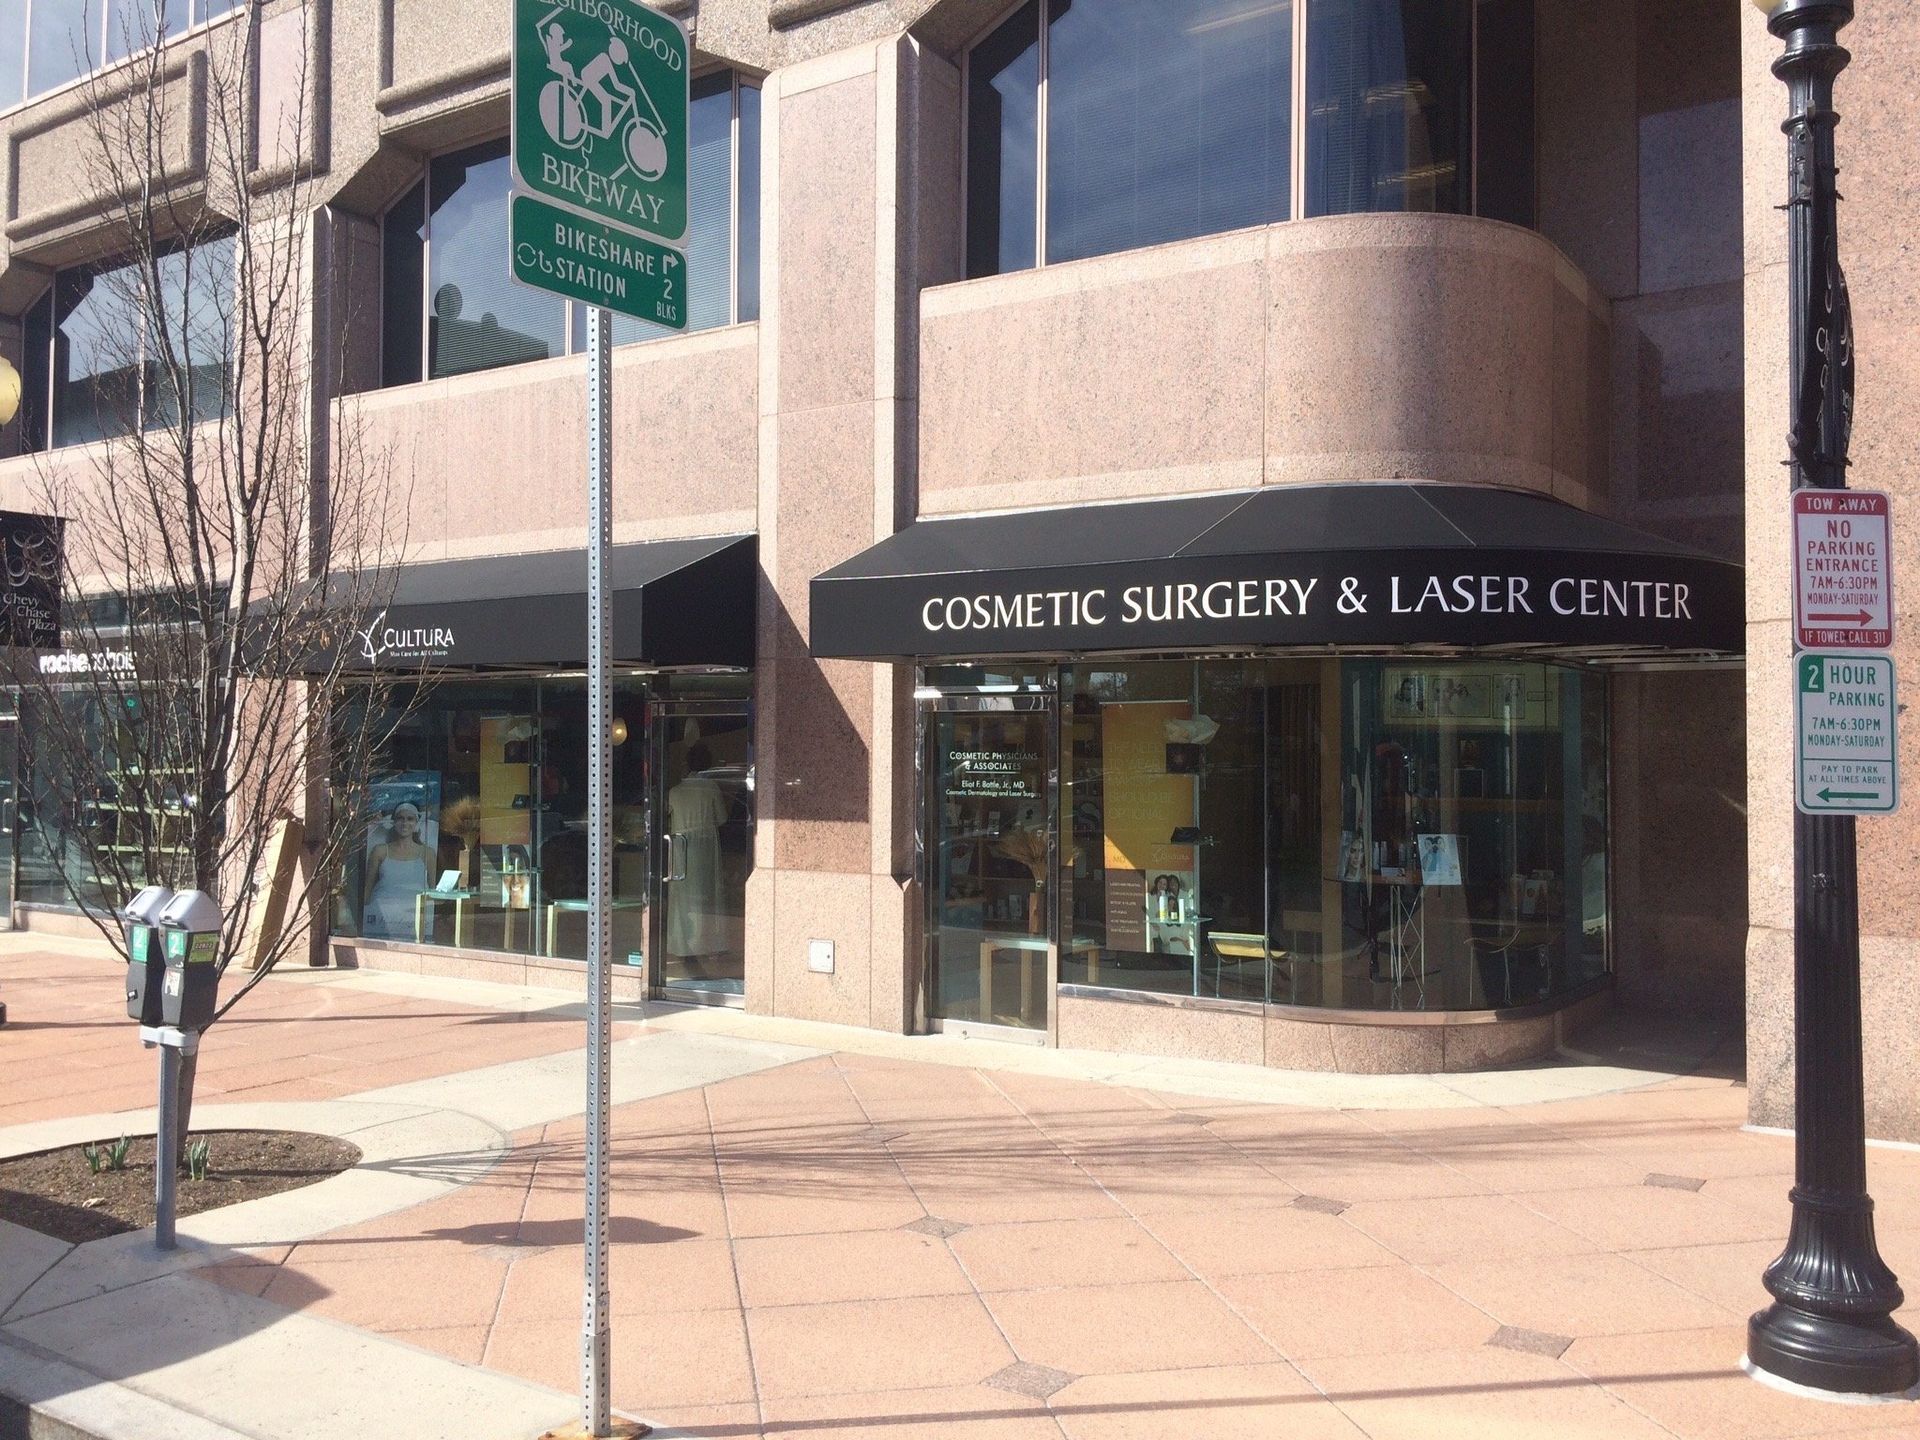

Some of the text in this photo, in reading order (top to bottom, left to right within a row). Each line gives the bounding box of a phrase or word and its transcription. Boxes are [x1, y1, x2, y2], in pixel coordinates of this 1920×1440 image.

[537, 0, 681, 71] BORHOOD
[542, 152, 665, 224] BIKEWAY
[555, 223, 655, 276] BIKESHARE
[555, 257, 626, 299] STATION
[663, 279, 673, 300] 2
[656, 301, 677, 321] BLKS
[1806, 497, 1877, 511] TOW AWAY
[1827, 519, 1851, 538] NO
[1808, 540, 1875, 556] PARKING
[1806, 558, 1878, 572] ENTRANCE
[1811, 575, 1878, 590] 7AM-6:30PM
[922, 575, 1692, 632] COSMETIC SURGERY & LASER CENTER
[1807, 592, 1878, 605] MONDAY-SATURDAY
[16, 605, 51, 619] Chase
[27, 618, 56, 631] Plaza
[384, 628, 455, 648] CULTURA
[1805, 630, 1886, 644] IF TOWED CALL 311
[1808, 664, 1876, 689] 2 HOUR
[1829, 691, 1885, 707] PARKING
[1812, 716, 1881, 731] 7AM-6:30PM
[1807, 734, 1885, 747] MONDAY-SATURDAY
[949, 751, 990, 760] COSMETIC
[973, 762, 1021, 771] ASSOCIATES
[1821, 765, 1878, 774] PAY TO PARK
[1013, 780, 1025, 788] MD
[1808, 775, 1886, 784] AT ALL TIMES ABOVE
